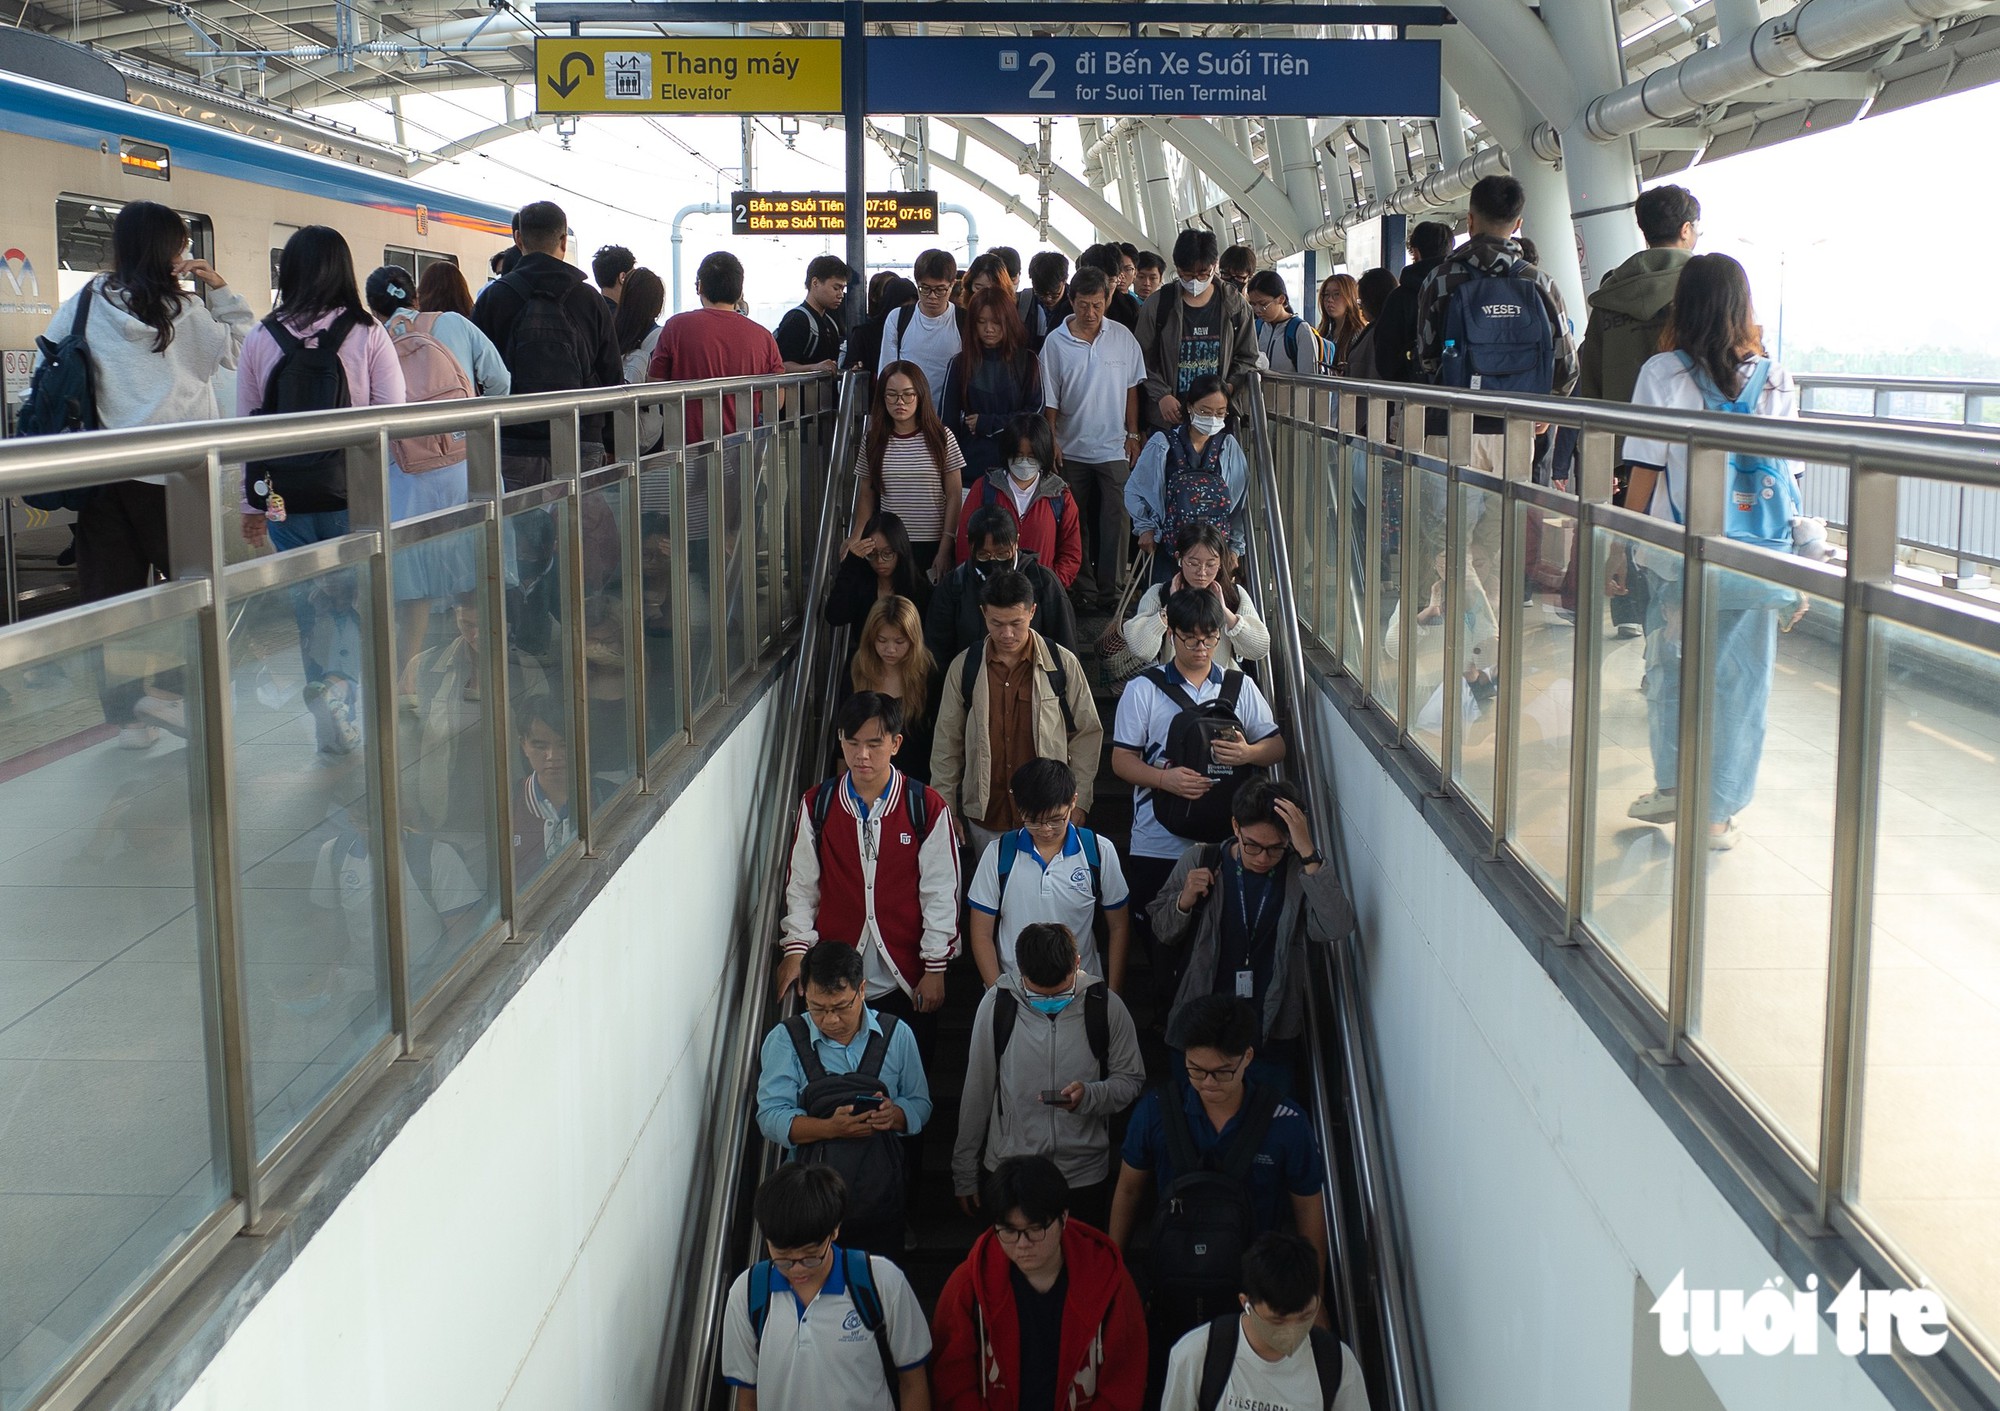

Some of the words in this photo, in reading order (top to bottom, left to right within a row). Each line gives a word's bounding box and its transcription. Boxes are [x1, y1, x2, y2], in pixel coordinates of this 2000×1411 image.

[661, 51, 738, 80] Thang
[747, 51, 800, 80] máy
[1004, 56, 1014, 65] L1
[1075, 51, 1096, 75] đi
[1105, 49, 1151, 75] Bến
[1160, 52, 1190, 75] Xe
[1197, 49, 1251, 75] Suối
[1258, 52, 1310, 76] Tiên
[1028, 52, 1056, 99] 2
[661, 84, 732, 100] Elevator
[1076, 84, 1101, 100] for
[1105, 84, 1144, 100] Suoi
[1148, 84, 1185, 100] Tien
[1189, 84, 1267, 101] Terminal
[749, 198, 773, 212] Bến
[775, 200, 789, 212] xe
[791, 198, 817, 212] Suối
[819, 200, 845, 212] Tiên
[865, 200, 898, 212] 07:16
[735, 204, 748, 223] 2
[899, 208, 932, 220] 07:16
[750, 215, 773, 229] Bến
[775, 218, 789, 229] xe
[791, 215, 817, 229] Suối
[819, 217, 845, 229] Tiên
[865, 217, 898, 229] 07:24
[1481, 304, 1522, 315] WESET
